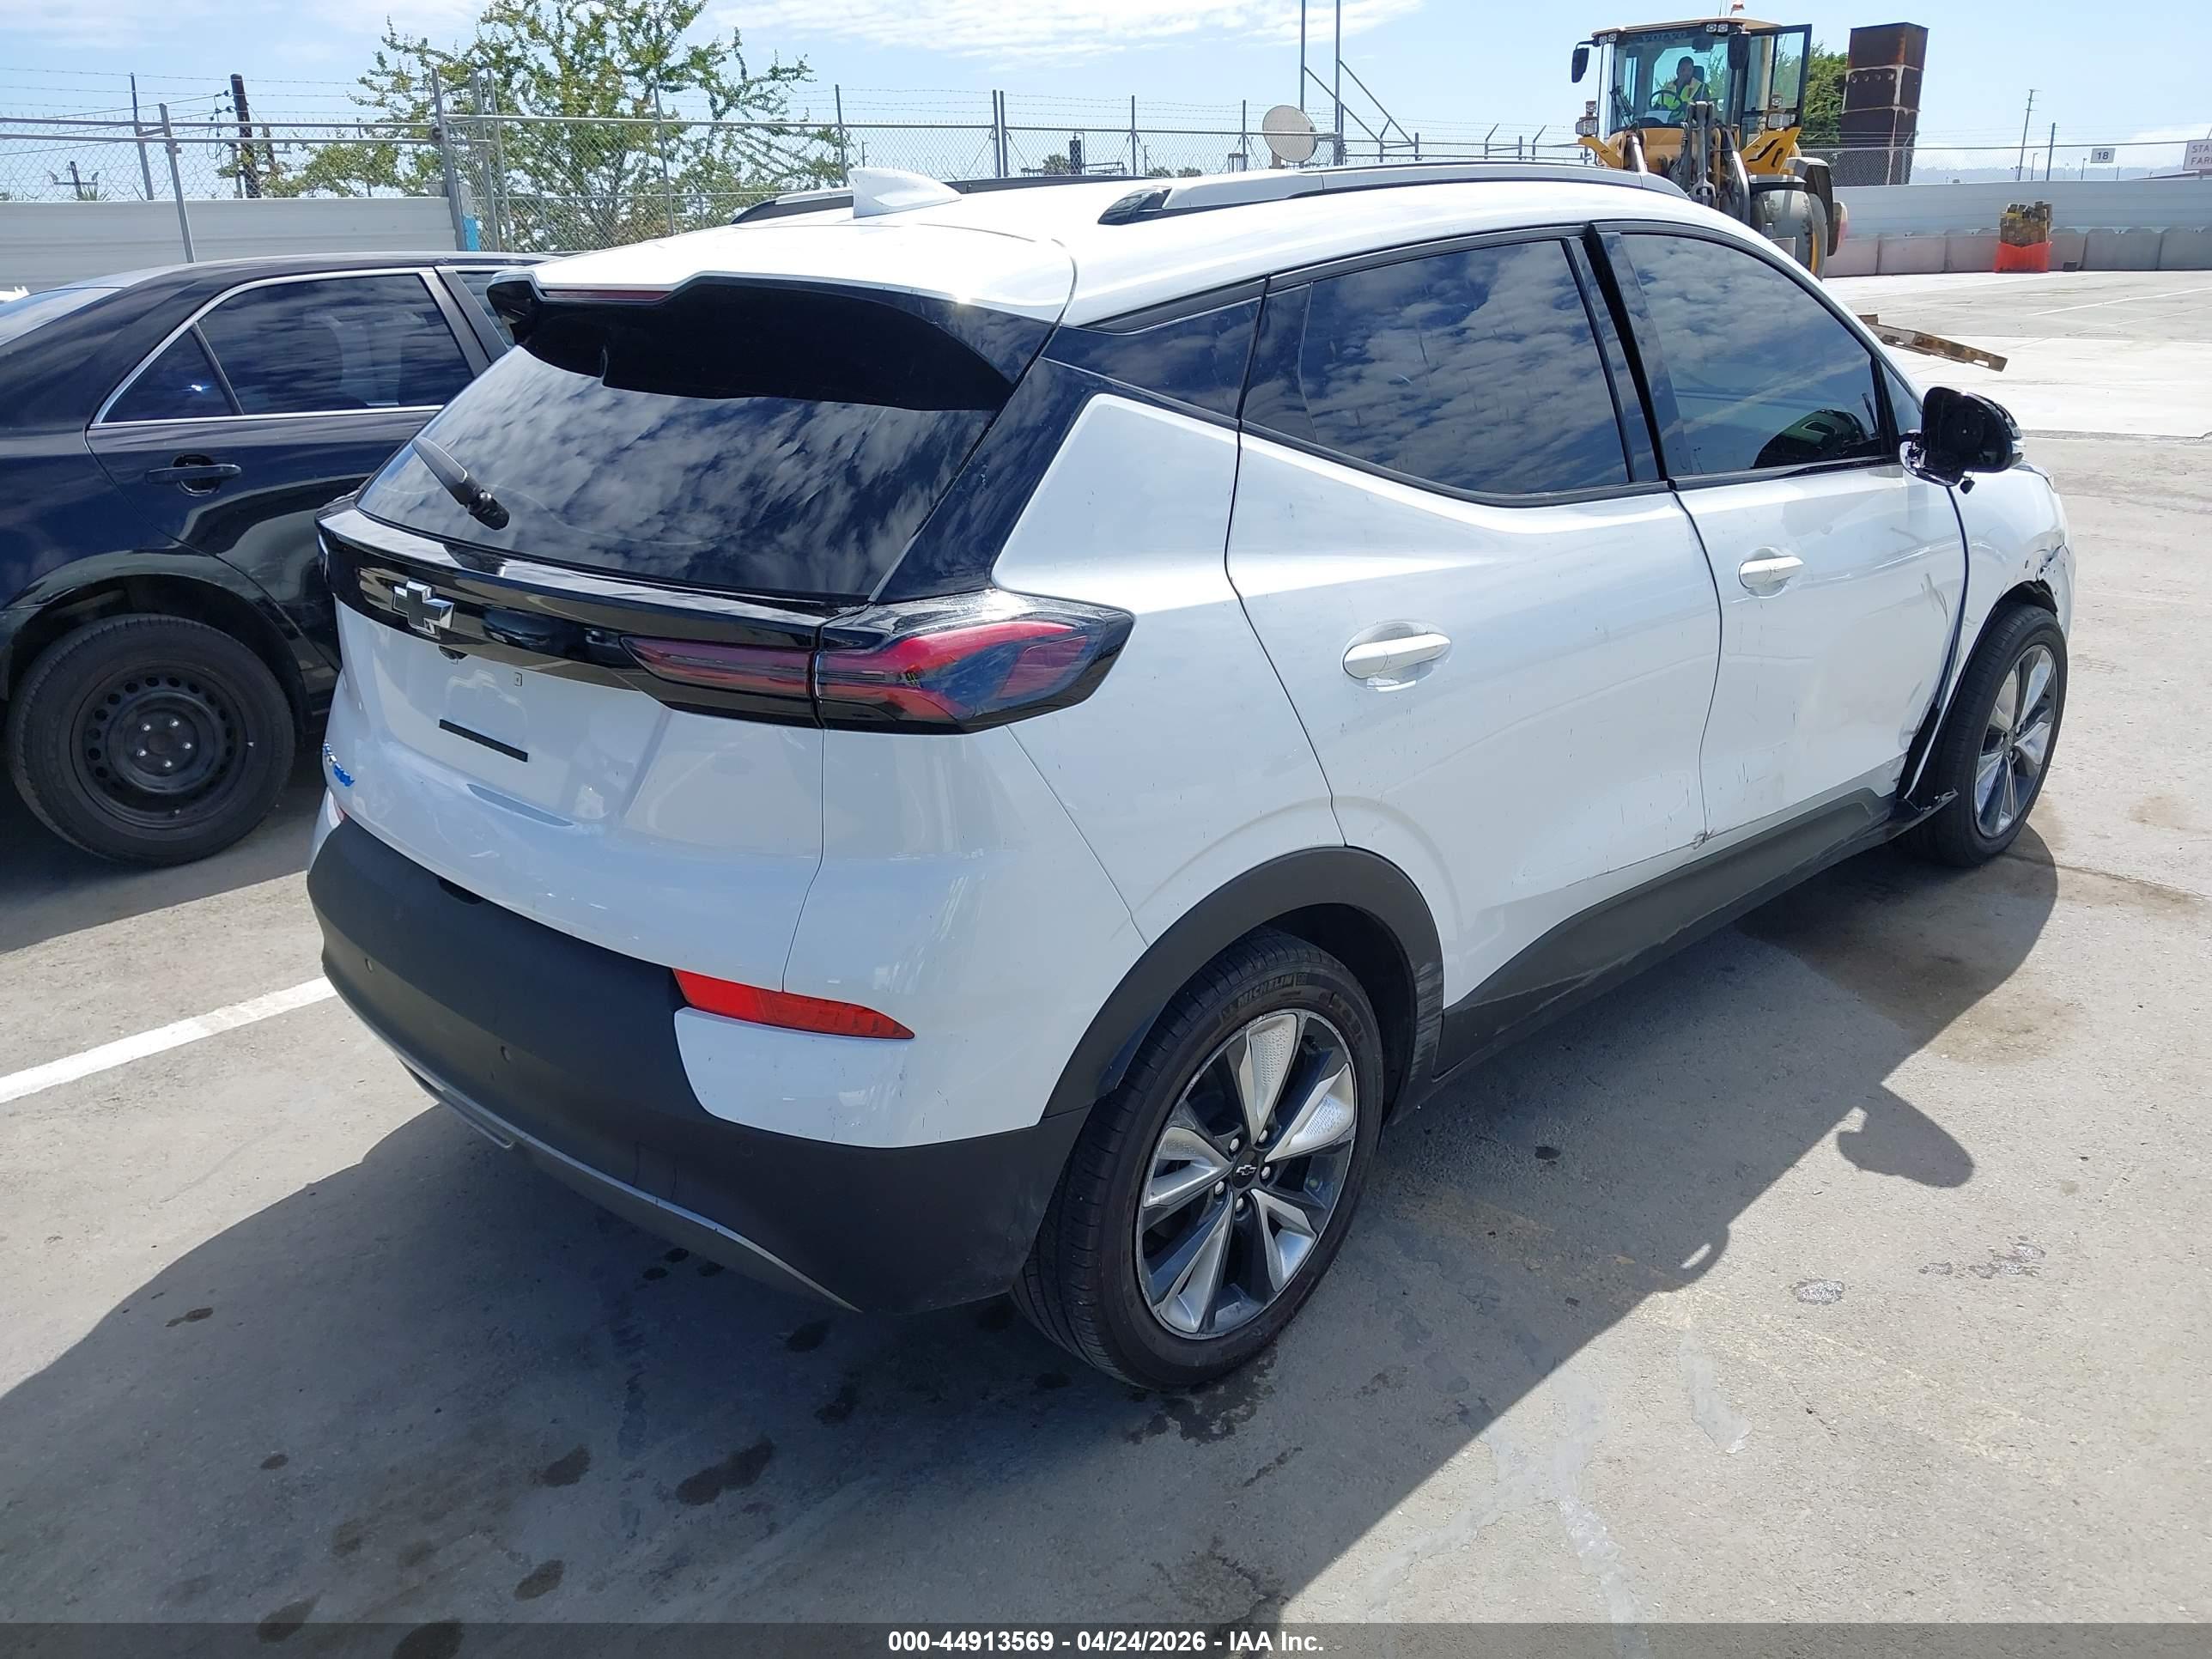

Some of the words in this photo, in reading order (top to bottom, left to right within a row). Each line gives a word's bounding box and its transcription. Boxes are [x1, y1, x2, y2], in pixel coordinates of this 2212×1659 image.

[2191, 144, 2212, 153] STA
[2097, 151, 2109, 160] 18
[1237, 975, 1293, 1006] MICHELIN
